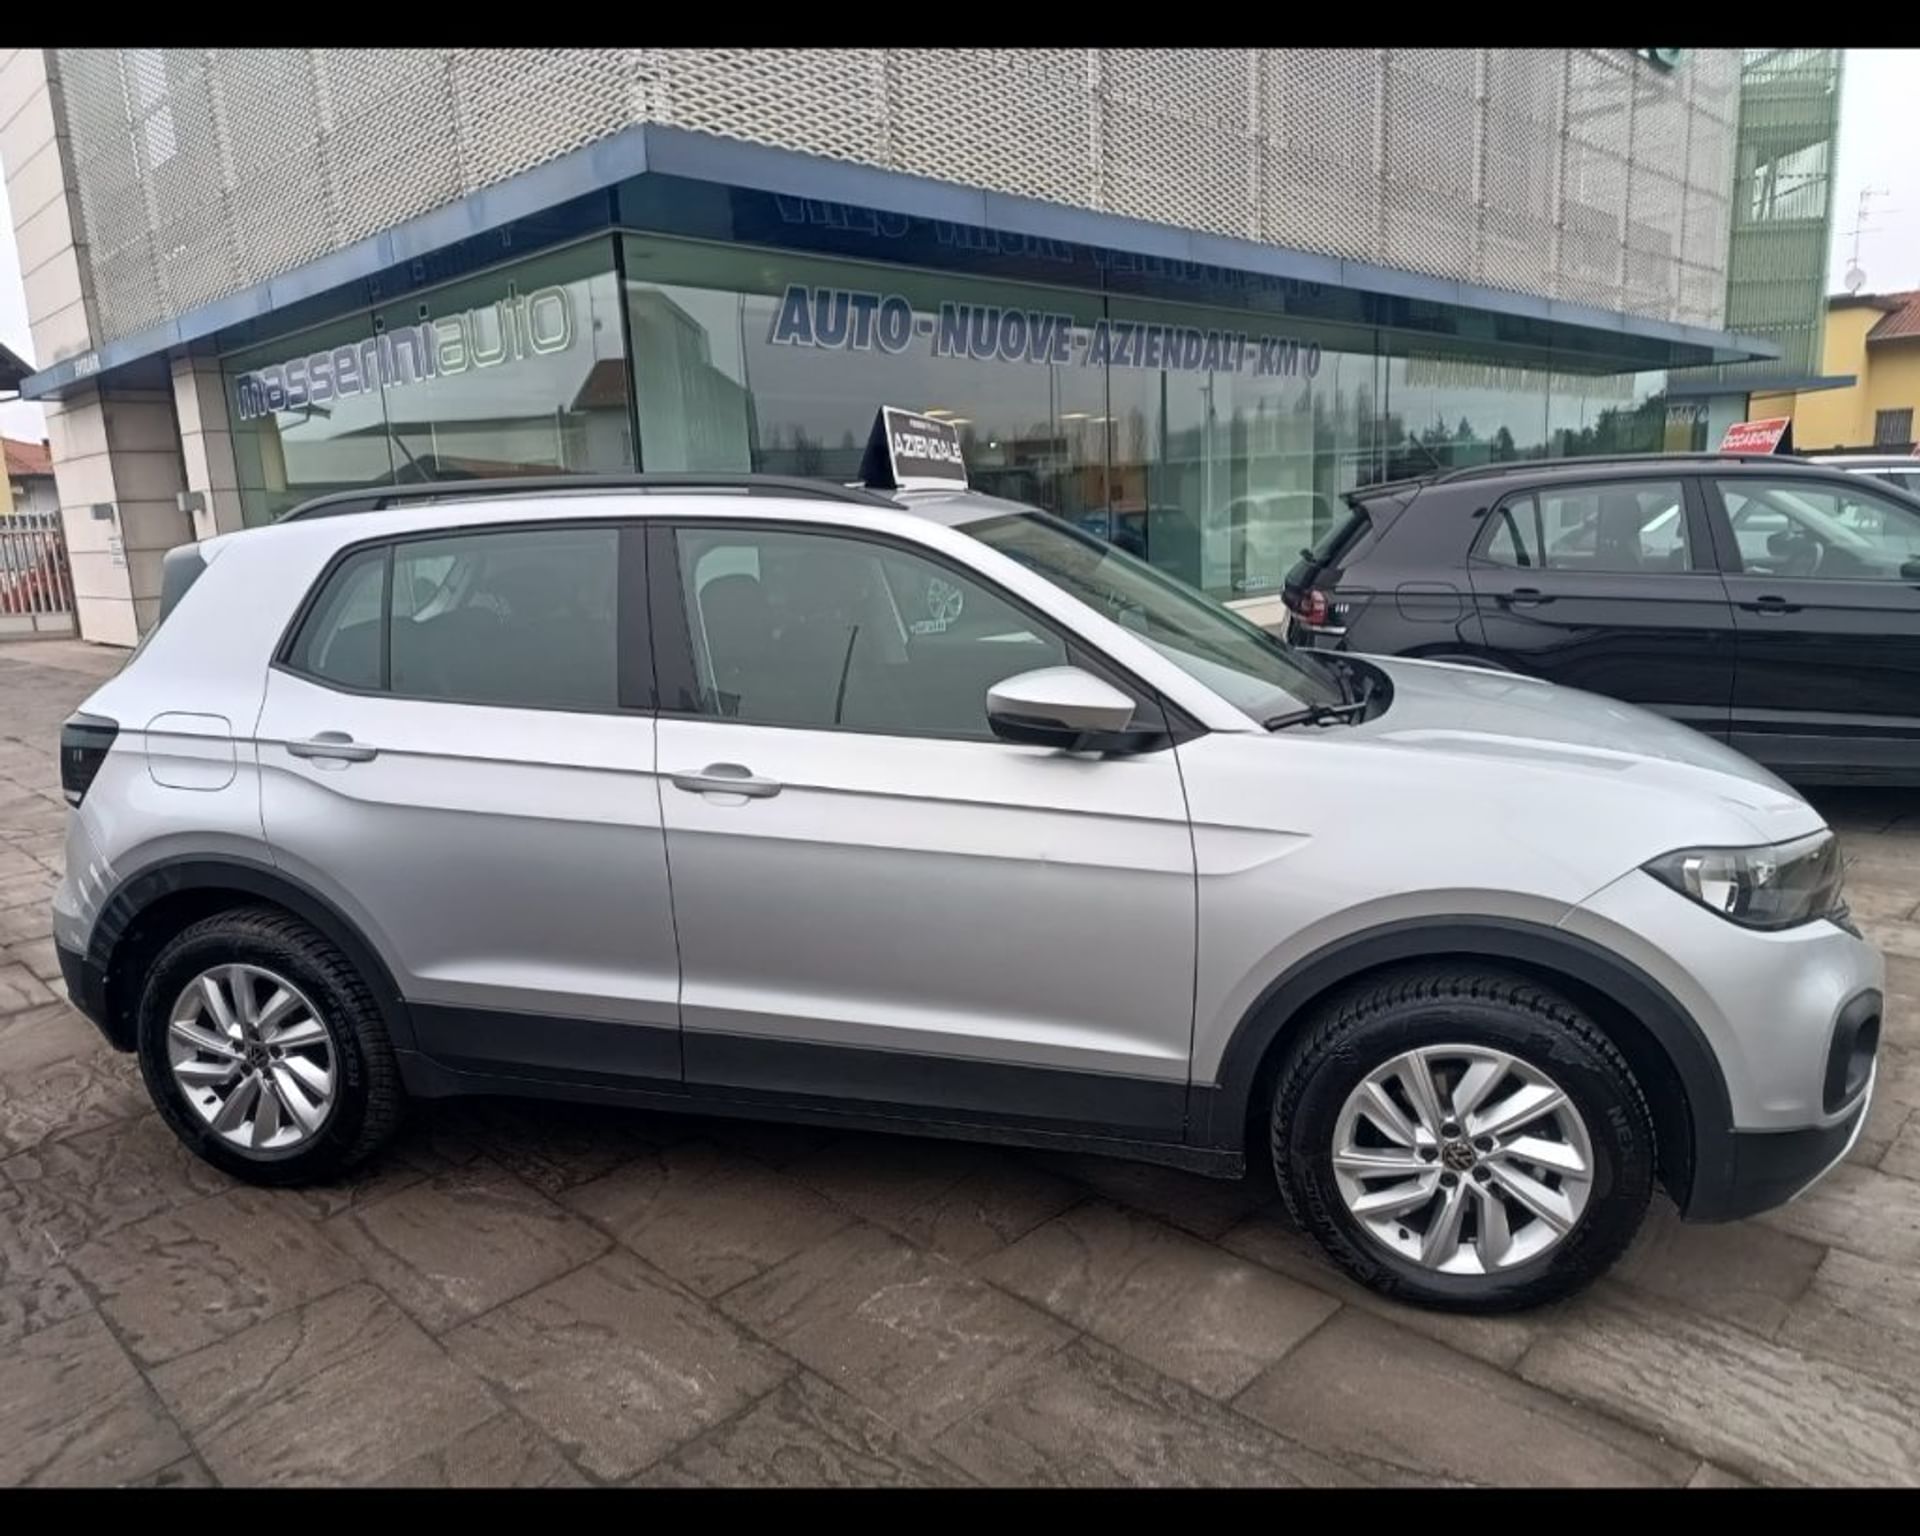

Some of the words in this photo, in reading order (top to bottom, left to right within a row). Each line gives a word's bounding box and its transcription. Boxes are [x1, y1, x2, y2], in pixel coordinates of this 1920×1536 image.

[772, 284, 913, 354] AUTO
[937, 300, 1074, 365] NUOVE
[1087, 318, 1248, 373] AZIENDALI
